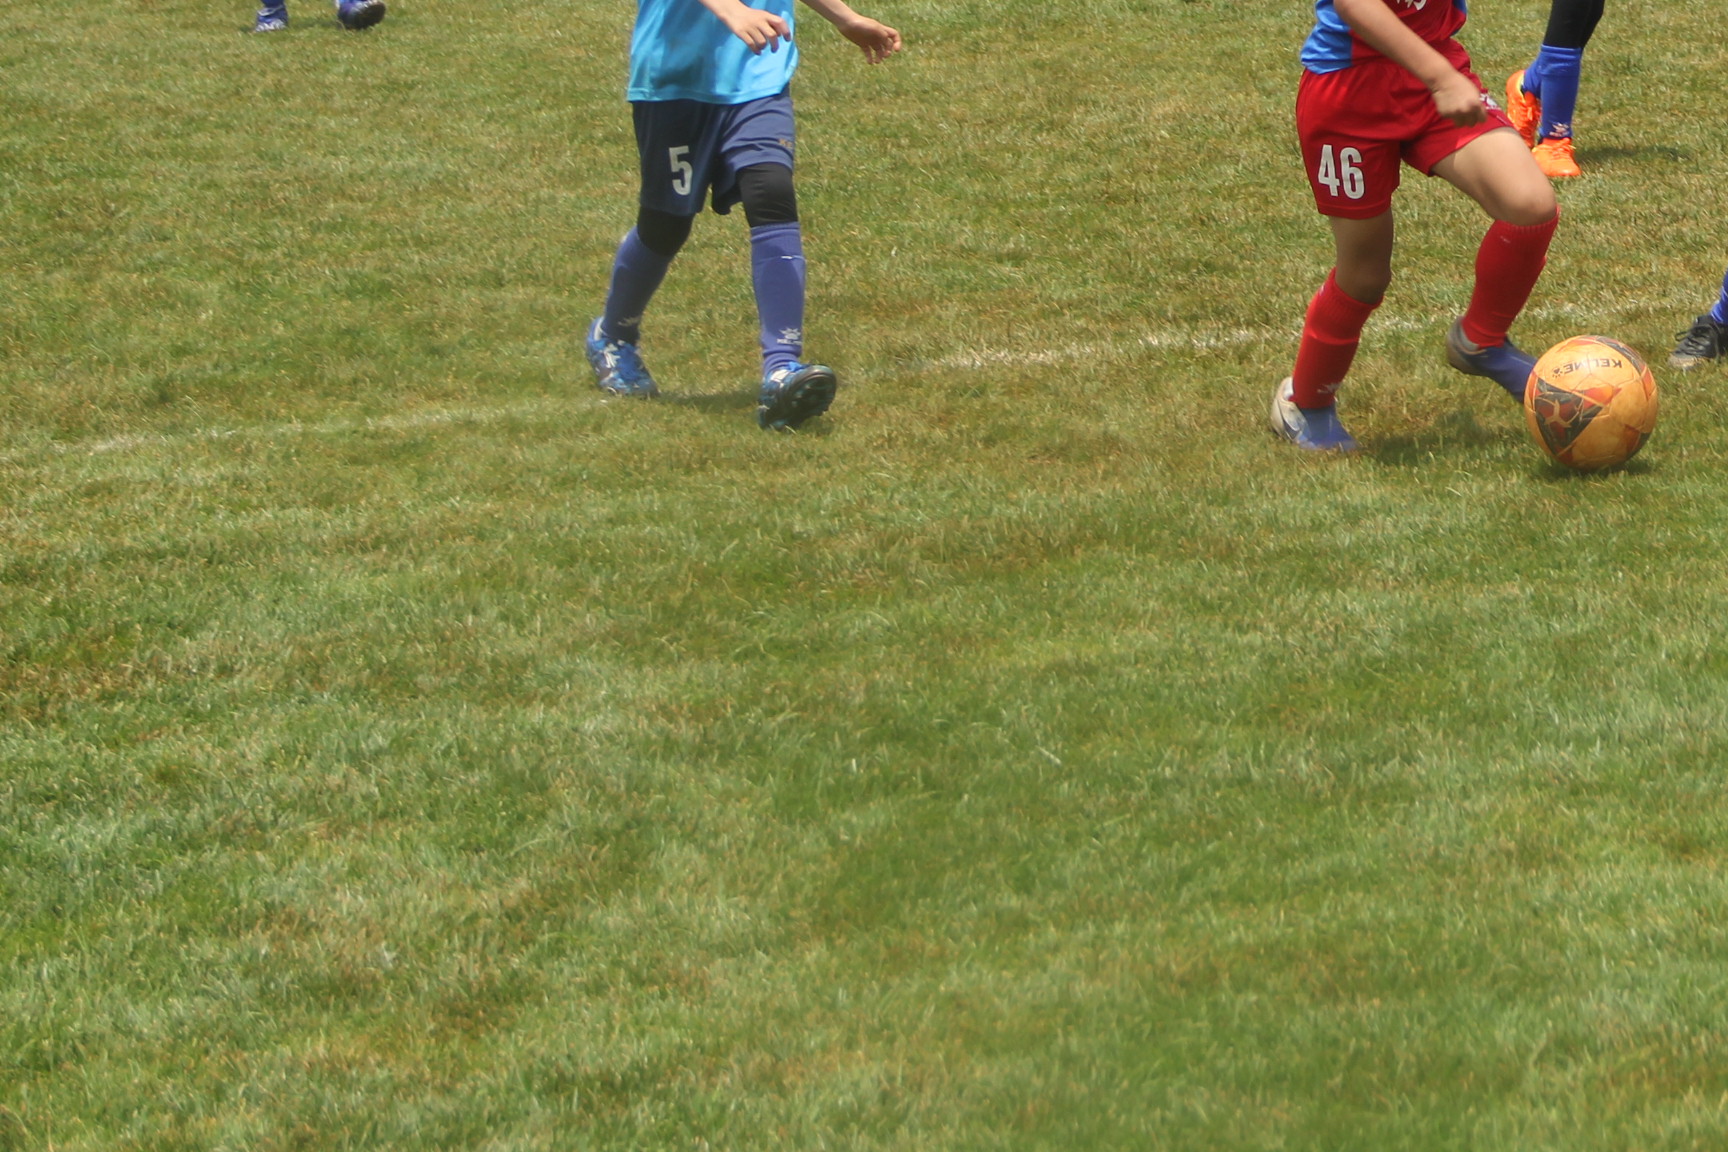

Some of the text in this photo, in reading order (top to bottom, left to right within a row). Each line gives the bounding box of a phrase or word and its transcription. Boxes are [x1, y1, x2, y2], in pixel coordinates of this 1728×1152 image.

[668, 146, 693, 196] 5
[1317, 144, 1366, 200] 46
[1564, 359, 1622, 375] KELME
